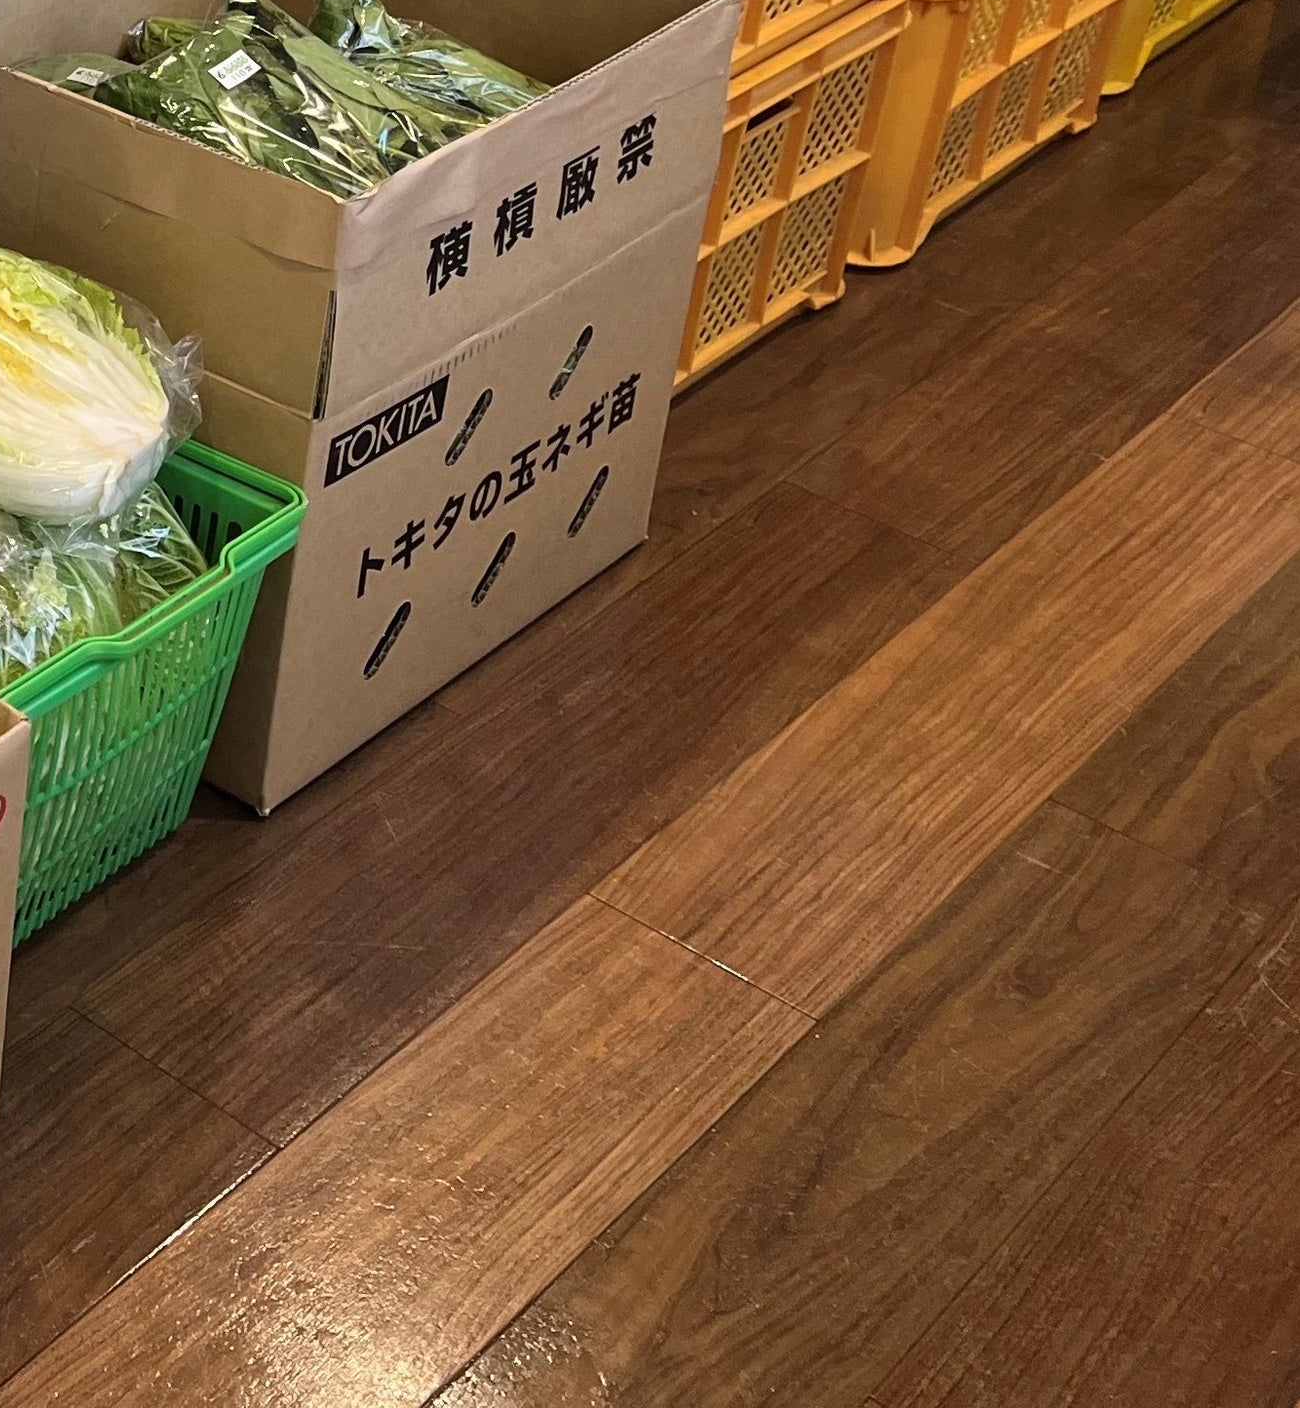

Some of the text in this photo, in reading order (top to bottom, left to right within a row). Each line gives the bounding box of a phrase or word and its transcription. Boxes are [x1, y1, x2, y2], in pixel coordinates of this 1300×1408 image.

[331, 389, 441, 479] TOKITA
[354, 373, 642, 599] トキタの玉ネギ苗
